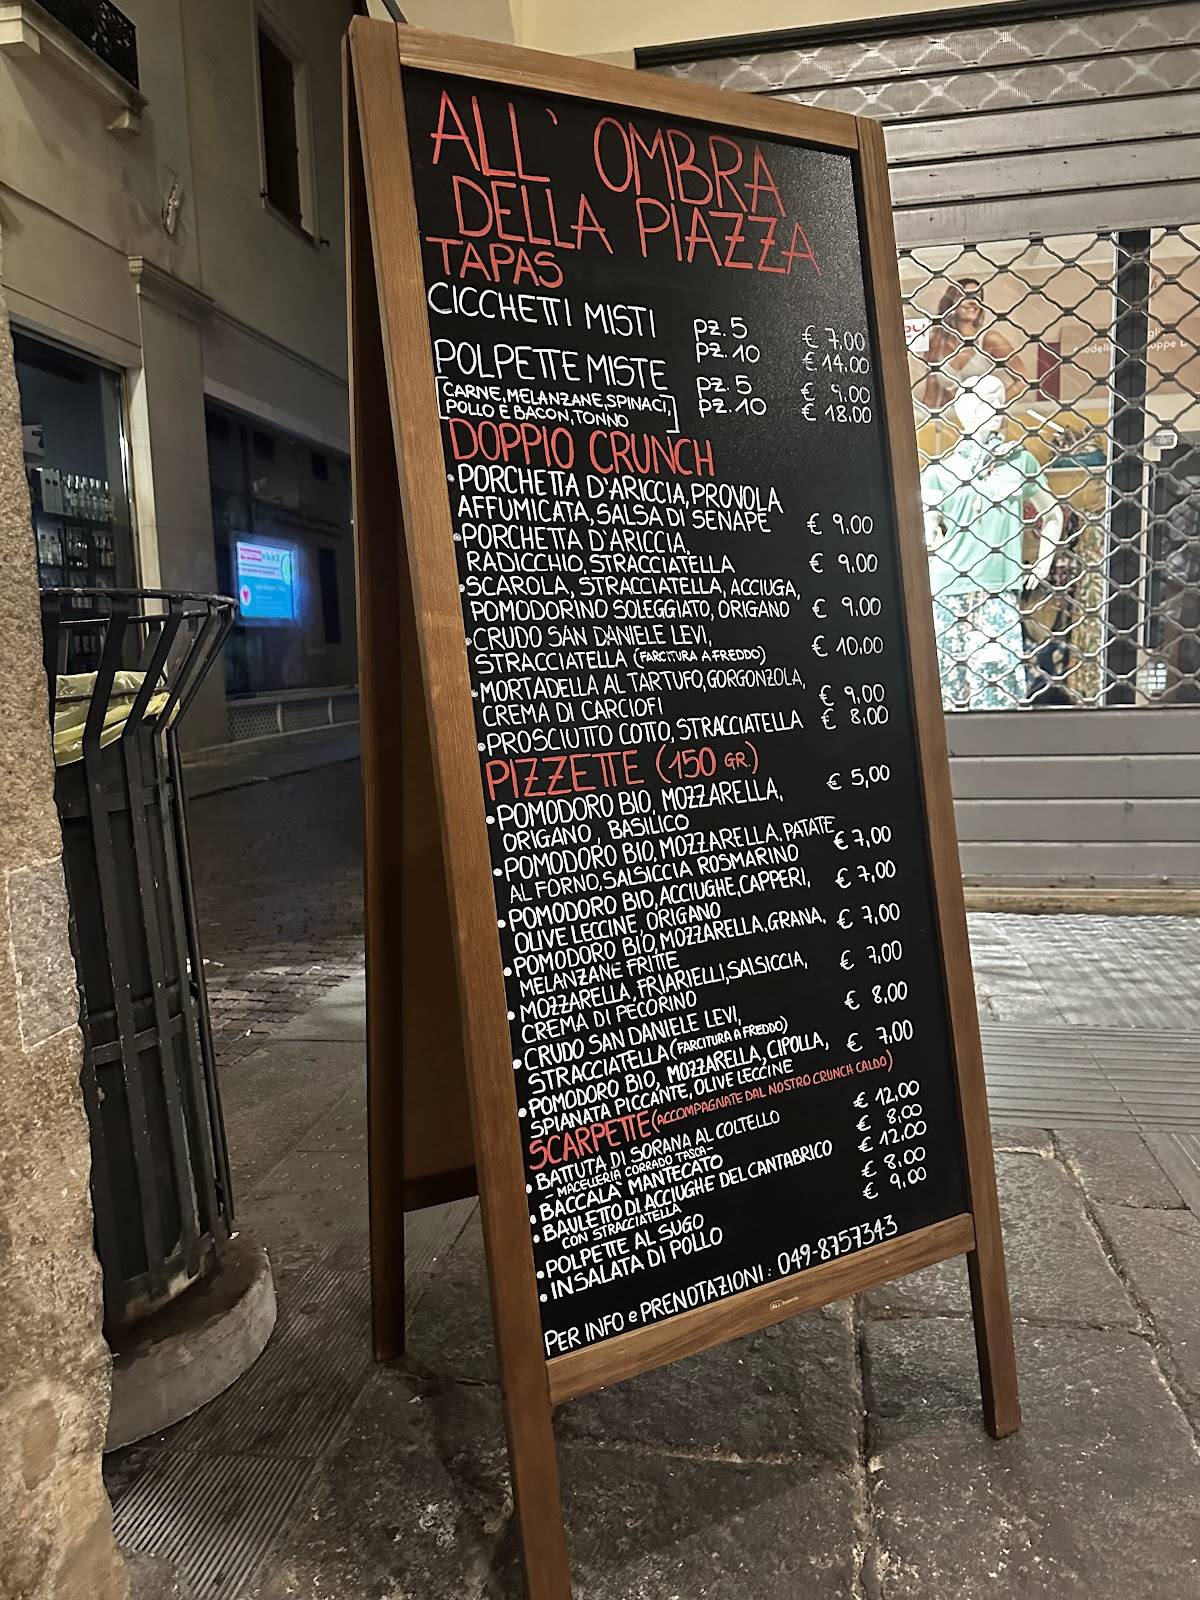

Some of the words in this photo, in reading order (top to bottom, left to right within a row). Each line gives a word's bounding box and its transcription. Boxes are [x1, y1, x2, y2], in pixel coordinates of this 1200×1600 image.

[594, 117, 786, 217] OMBRA
[453, 175, 613, 254] DELLA
[635, 197, 822, 276] PIAZZA
[426, 236, 563, 288] TAPAS
[428, 282, 572, 326] CICCHETTI
[584, 302, 656, 338] MISTI
[434, 339, 580, 381] POLPETTE
[587, 353, 668, 390] MISTE
[446, 399, 494, 418] POLLO
[500, 404, 509, 417] E
[574, 410, 629, 428] TONNO
[449, 418, 574, 469] DOPPIO
[589, 430, 715, 477] CRUNCH
[458, 463, 580, 497] PORCHETTA
[691, 483, 784, 514] PROVOLA
[596, 503, 664, 527] SALSA
[666, 507, 686, 527] DI
[692, 509, 772, 533] SENAPE
[462, 522, 583, 550] PORCHETTA
[589, 553, 736, 574] STRACCIATELLA
[465, 575, 575, 599] SCAROLA,
[578, 575, 727, 599] STRACCIATELLA,
[730, 577, 801, 600] ACCIUGA,
[470, 599, 608, 622] POMODORINO
[613, 599, 714, 621] SOLEGGIATO,
[718, 600, 790, 619] ORIGANO
[472, 625, 542, 651] CRUDO
[547, 624, 588, 647] SAN
[593, 624, 666, 647] DANIELE
[670, 624, 713, 647] LEVI,
[475, 648, 628, 674] STRACCIATELLA
[633, 647, 697, 669] (FARCITURA
[712, 645, 766, 666] FREDDO)
[480, 674, 600, 704] MORTADELLA
[603, 673, 626, 695] AL
[627, 669, 706, 693] TARTUFO,
[707, 667, 806, 690] GORGONZOLA,
[483, 702, 551, 727] CREMA
[556, 701, 575, 723] DI
[581, 696, 664, 721] CARCIOFI
[486, 725, 613, 756] PROSCIUTTO
[618, 720, 674, 745] COTTO,
[677, 709, 804, 741] STRACCIATELLA
[485, 750, 644, 801] PIZZETTE
[655, 743, 716, 783] (150
[724, 741, 759, 774] GR.)
[497, 793, 614, 830] POMODORO
[661, 777, 784, 812] MOZZARELLA,
[851, 765, 890, 789] 5,00
[504, 844, 617, 882] POMODORO
[783, 816, 836, 841] PATATE
[851, 826, 892, 847] 7,00
[607, 814, 690, 840] BASILICO
[508, 895, 617, 932] POMODORO
[622, 889, 658, 911] BIO,
[659, 876, 741, 906] ACCIUGHE,
[739, 866, 811, 894] CAPPERI,
[857, 860, 896, 883] 7,00
[510, 884, 532, 904] AL
[602, 860, 693, 890] SALSICCIA
[697, 844, 799, 875] ROSMARINO
[513, 940, 616, 977] POMODORO
[660, 915, 768, 950] MOZZARELLA,
[861, 903, 900, 925] 7,00
[514, 927, 568, 954] OLIVE
[570, 913, 644, 944] LECCINE,
[646, 902, 721, 930] ORIGANO
[519, 962, 623, 998] MELANZANE
[626, 951, 680, 976] FRITTE
[520, 982, 637, 1023] MOZZARELLA,
[728, 950, 808, 984] SALSICCIA,
[866, 940, 903, 964] 7,00
[521, 1013, 589, 1044] CREMA
[593, 1009, 611, 1028] DI
[616, 990, 697, 1023] PECORINO
[524, 1038, 584, 1071] CRUDO
[589, 1029, 625, 1055] SAN
[628, 1012, 700, 1046] DANIELE
[704, 1005, 741, 1028] LEVI,
[871, 981, 908, 1004] 8,00
[528, 1044, 669, 1095] STRACCIATELLA
[669, 1030, 732, 1060] (FARCITURA
[742, 1015, 788, 1039] FREDDO)
[528, 1079, 619, 1119] POMODORO
[625, 1070, 660, 1093] BIO,
[667, 1045, 767, 1083] MOZZARELLA,
[766, 1031, 829, 1060] CIPOLLA,
[875, 1020, 913, 1045] 7,00
[529, 1110, 651, 1170] SCARPETTE
[652, 1094, 743, 1133] (ACCOMPAGNATE
[745, 1087, 766, 1102] DAL
[768, 1073, 811, 1095] NOSTRO
[813, 1062, 853, 1085] CRUNCH
[855, 1049, 893, 1075] CALDO)
[530, 1103, 612, 1139] SPIANATA
[614, 1084, 692, 1116] PICCANTE,
[694, 1071, 734, 1097] OLIVE
[737, 1059, 793, 1083] LECCINE
[535, 1155, 606, 1191] BATTUTA
[611, 1150, 626, 1169] DI
[630, 1133, 692, 1163] SORANA
[695, 1128, 714, 1145] AL
[716, 1110, 780, 1139] COLTELLO
[875, 1080, 919, 1106] 12,00
[625, 1156, 673, 1178] CORRADO
[886, 1104, 922, 1125] 8,00
[628, 1155, 723, 1195] MANTECATO
[879, 1121, 927, 1146] 12,00
[542, 1204, 623, 1242] BAULETTO
[625, 1199, 642, 1216] DI
[644, 1175, 715, 1211] ACCIUGHE
[719, 1167, 747, 1188] DEL
[748, 1140, 832, 1178] CANTABRICO
[883, 1147, 925, 1170] 8,00
[546, 1237, 630, 1278] POLPETTE
[634, 1229, 656, 1250] AL
[658, 1213, 704, 1241] SUGO
[889, 1167, 927, 1190] 9,00
[562, 1231, 589, 1249] CON
[592, 1203, 682, 1241] STRACCIATELLA
[544, 1327, 581, 1356] PER
[584, 1312, 625, 1342] INFO
[628, 1311, 638, 1323] e
[777, 1214, 898, 1275] 049-8757343
[550, 1253, 645, 1299] INSALATA
[648, 1246, 666, 1267] DI
[669, 1227, 723, 1259] POLLO
